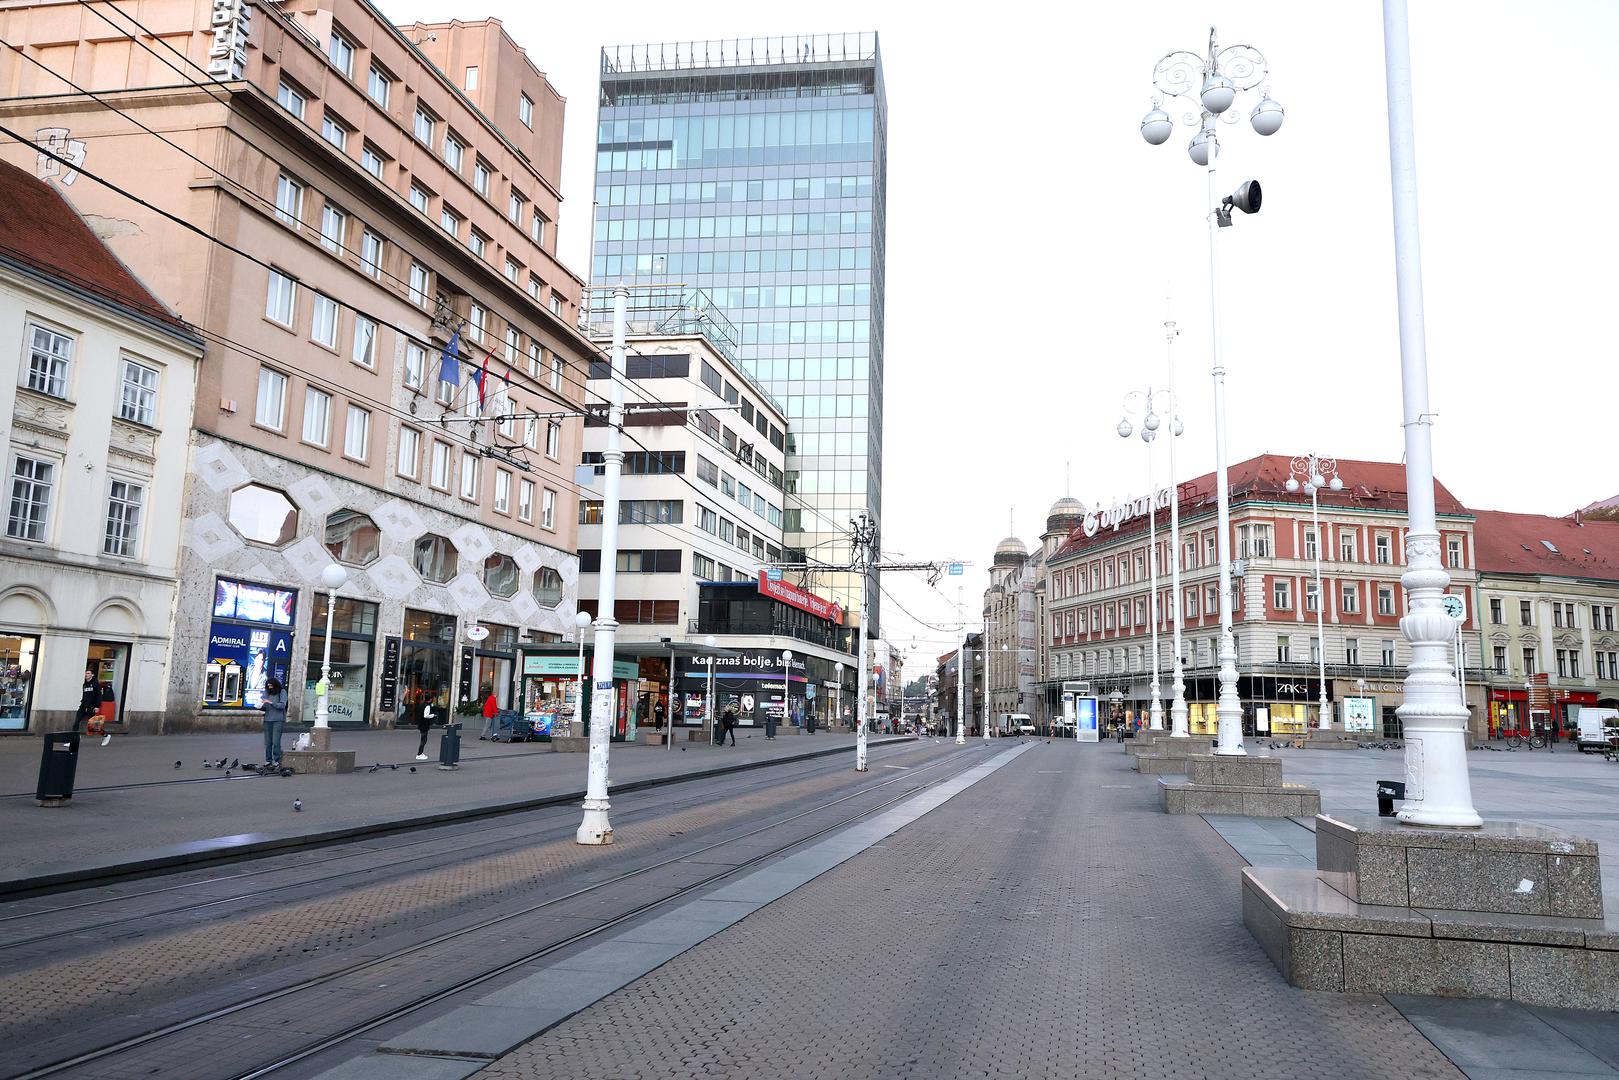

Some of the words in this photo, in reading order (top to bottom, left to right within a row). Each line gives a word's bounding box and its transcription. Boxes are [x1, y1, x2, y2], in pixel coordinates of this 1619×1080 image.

[211, 635, 247, 647] ADMIRAL
[275, 639, 286, 652] A
[692, 656, 713, 665] Kad
[716, 656, 741, 665] znaš
[743, 655, 774, 668] bolje,
[761, 682, 788, 690] telemac
[1277, 683, 1308, 694] ZAKS
[327, 704, 353, 718] CREAM
